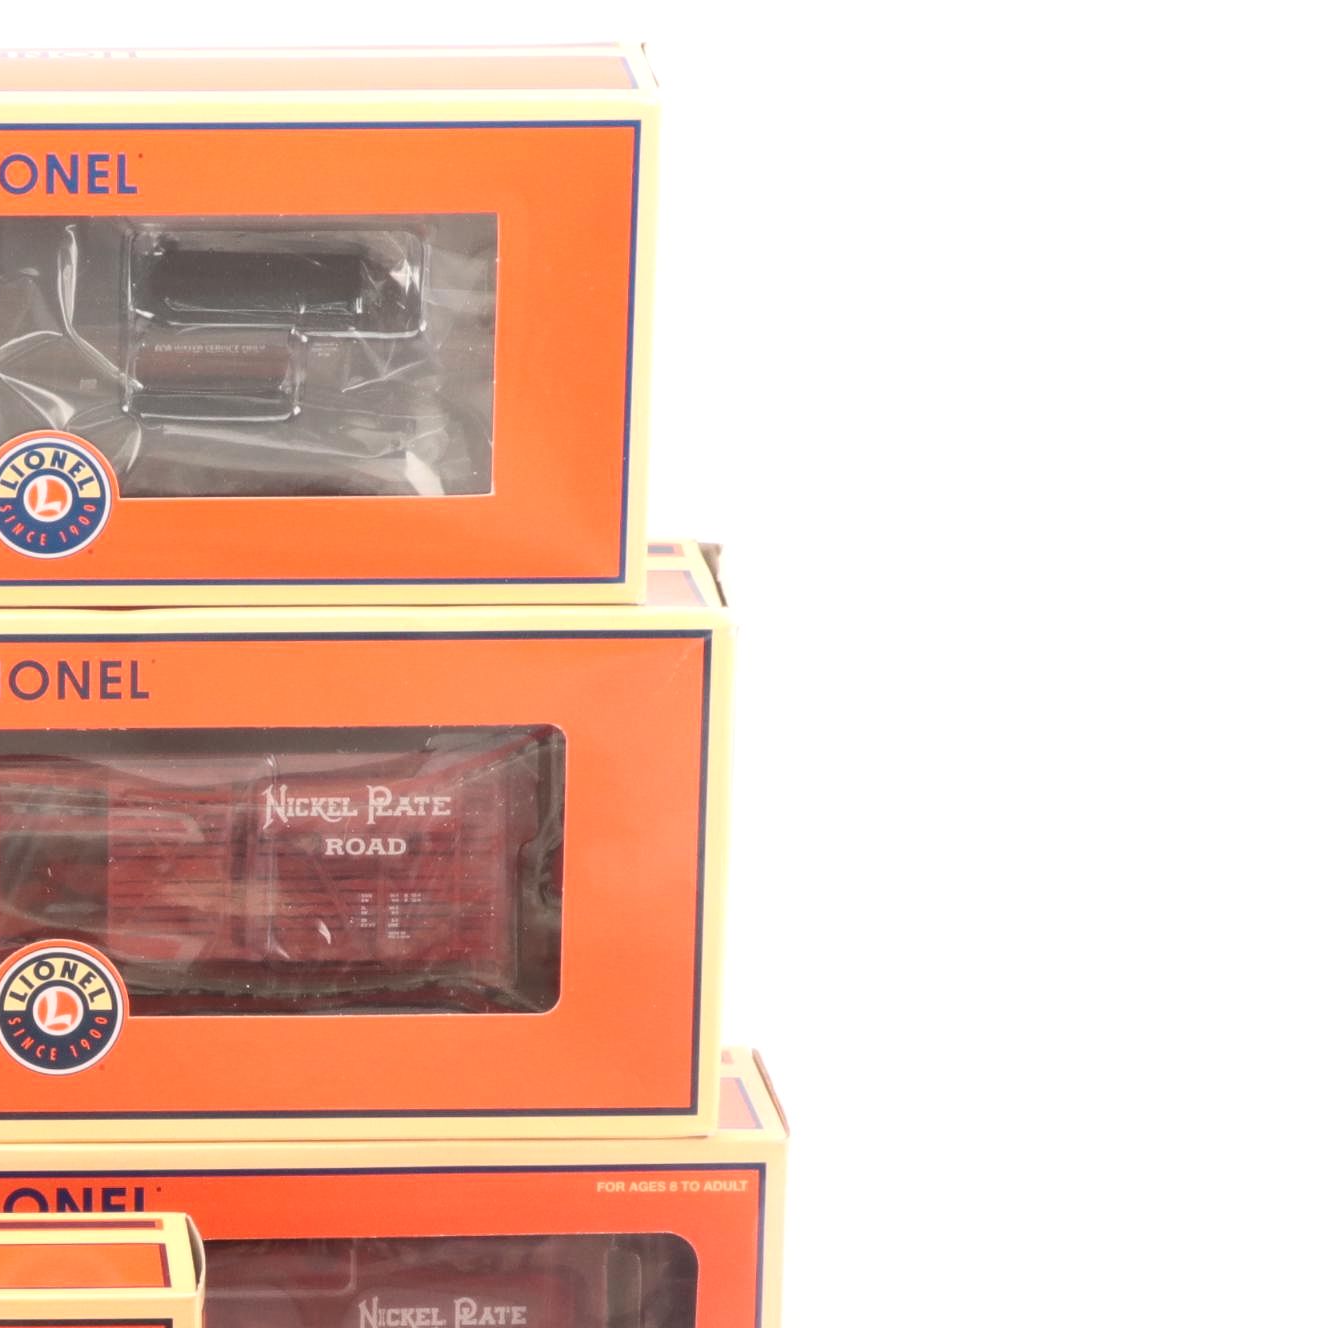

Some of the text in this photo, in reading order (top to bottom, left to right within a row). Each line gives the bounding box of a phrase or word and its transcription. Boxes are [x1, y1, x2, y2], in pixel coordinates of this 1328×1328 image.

[0, 449, 95, 491] LIONEL
[0, 504, 97, 546] SINCE 1900
[262, 784, 452, 830] NICKEL PLATE
[324, 838, 407, 856] ROAD
[9, 961, 106, 1003] LIONEL
[7, 1016, 109, 1061] SINCE 1900
[597, 1181, 625, 1193] FOR
[629, 1181, 666, 1192] AGES
[680, 1181, 700, 1192] TO
[703, 1180, 748, 1192] ADULT
